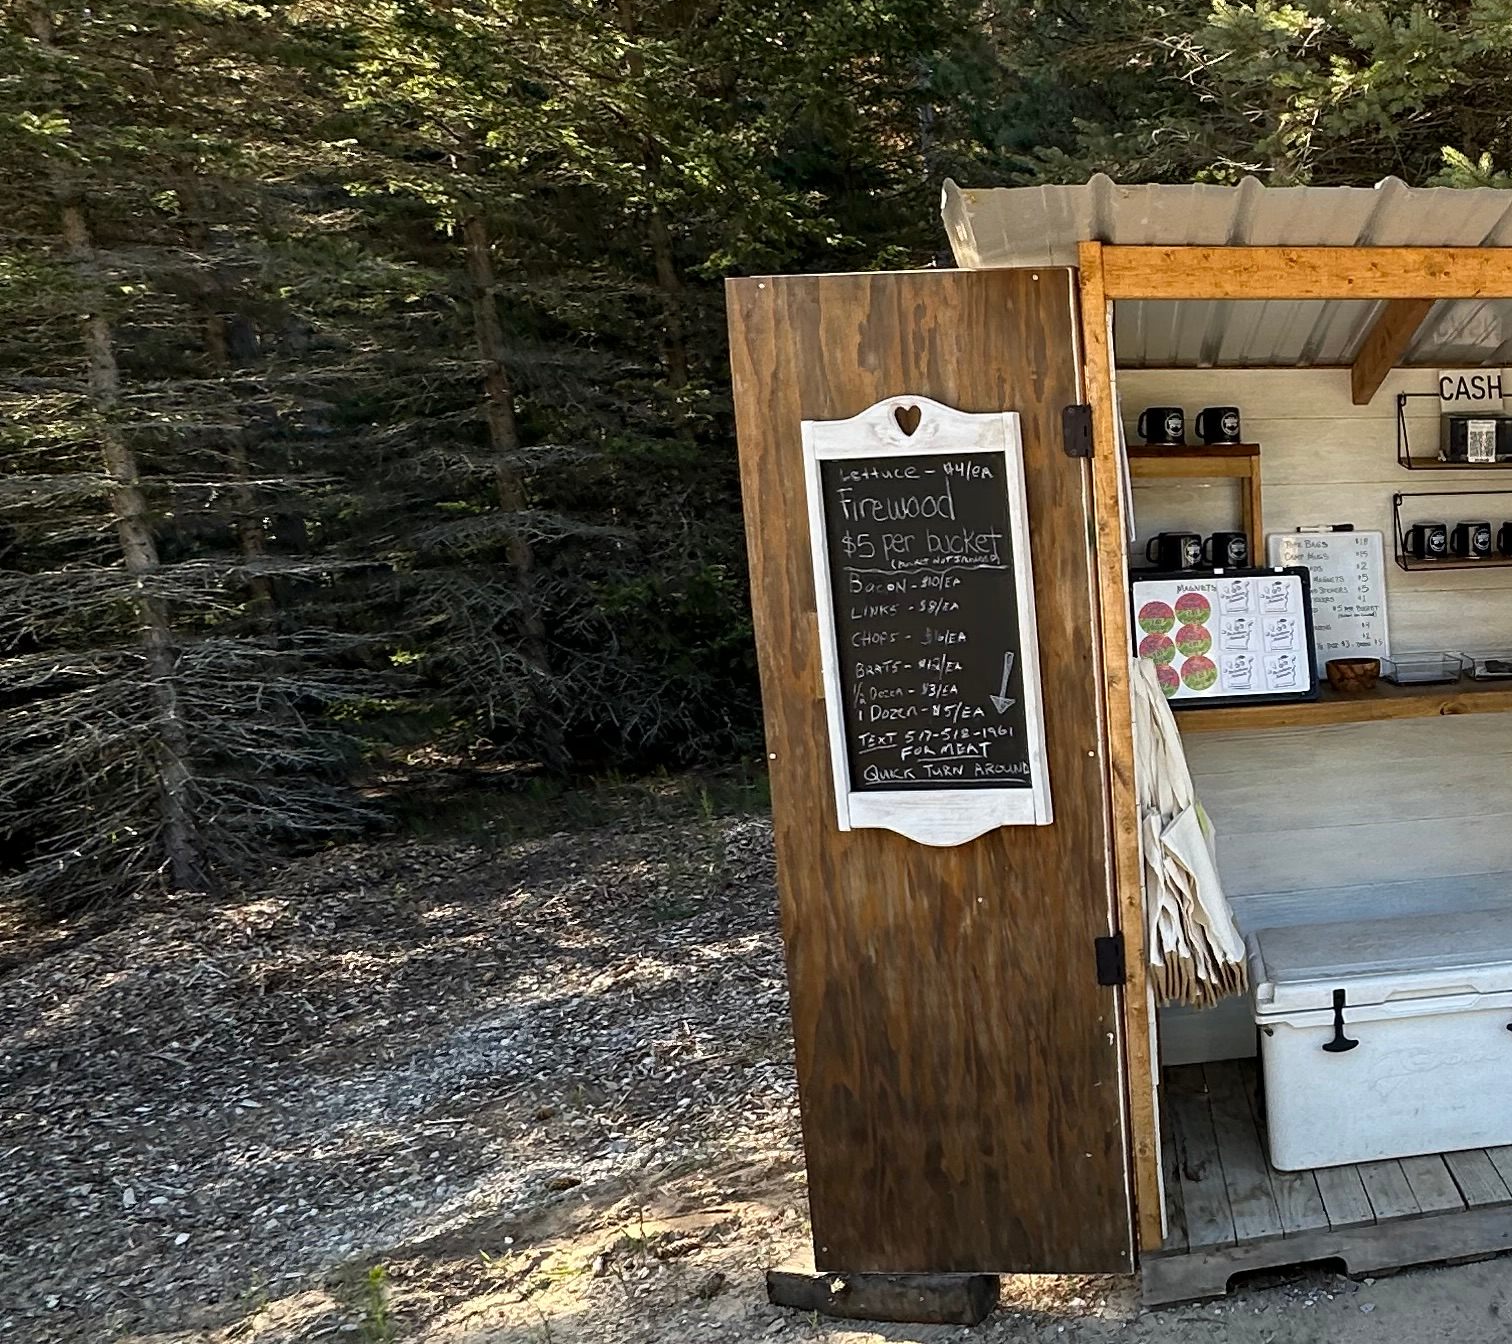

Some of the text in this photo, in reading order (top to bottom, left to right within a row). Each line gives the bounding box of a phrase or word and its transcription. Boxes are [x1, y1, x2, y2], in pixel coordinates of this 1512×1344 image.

[1440, 375, 1503, 401] CASH
[836, 476, 955, 521] Firewood
[841, 525, 1002, 561] $5 per bucket
[1177, 584, 1217, 594] MAGNETS
[851, 603, 900, 619] LINKS
[919, 597, 959, 616] $8/EA
[851, 630, 900, 647] CHOPS
[856, 659, 902, 678] BRATS
[905, 726, 1014, 742] 517-518-1961
[901, 742, 992, 761] FOR MEAT
[864, 761, 1030, 782] QUICK TURN AROUND
